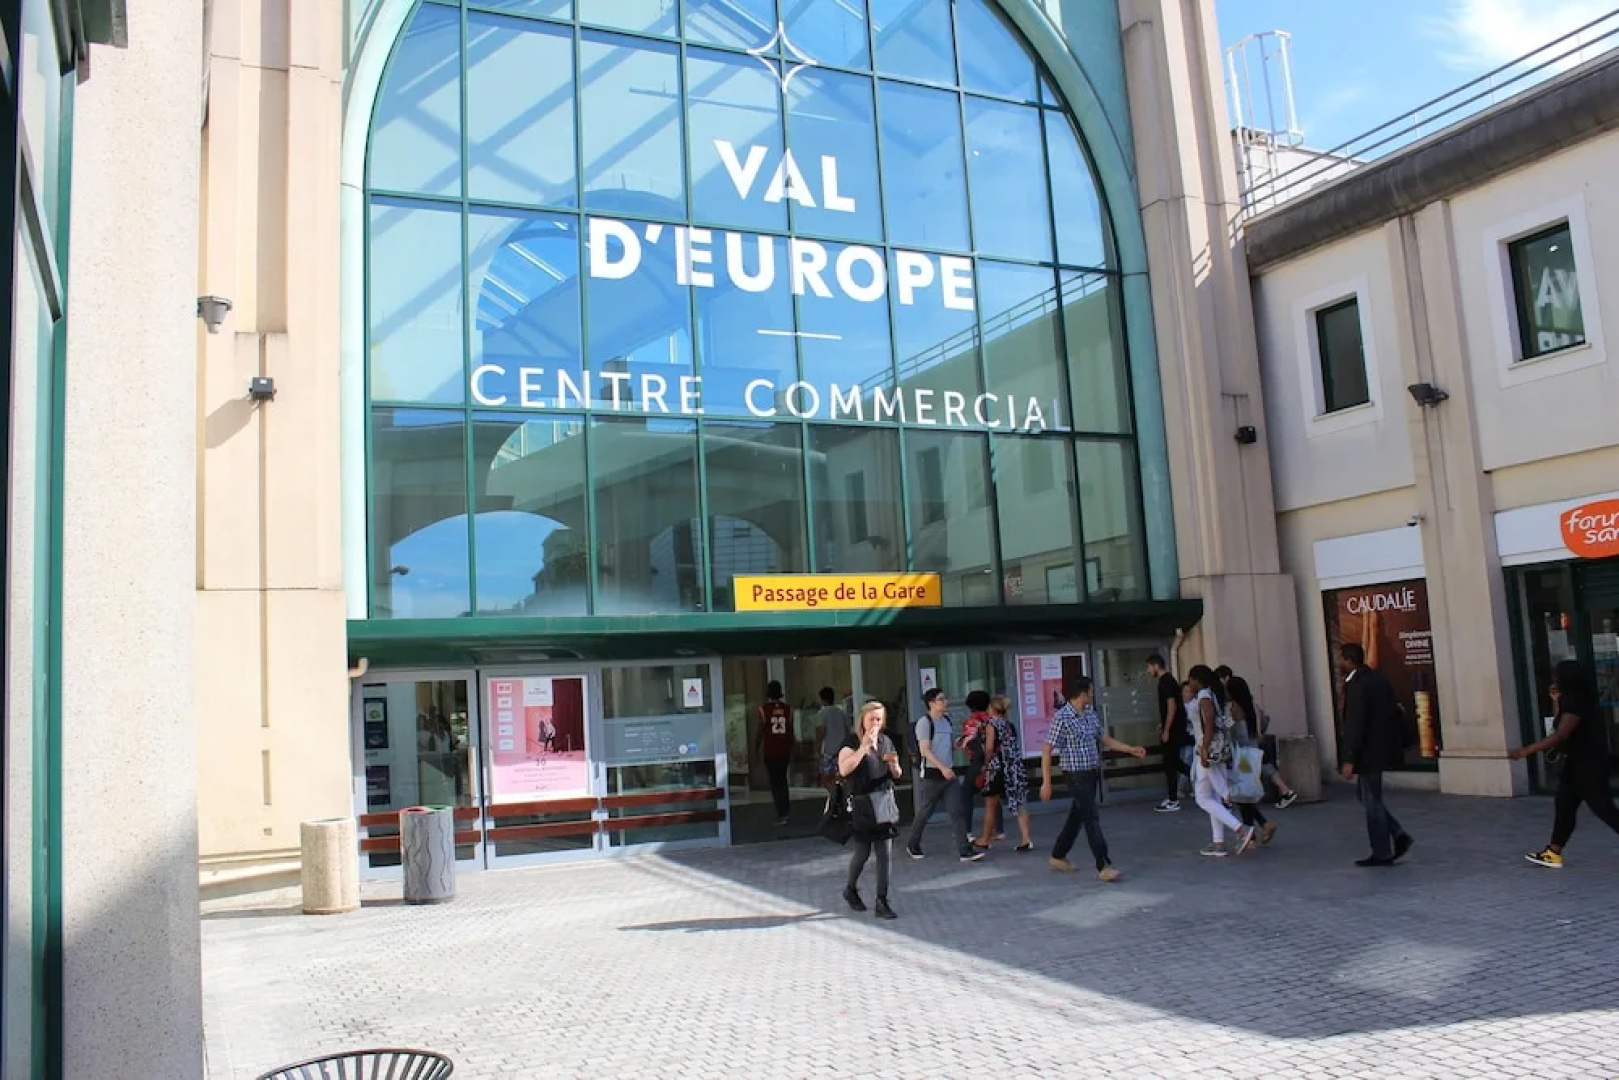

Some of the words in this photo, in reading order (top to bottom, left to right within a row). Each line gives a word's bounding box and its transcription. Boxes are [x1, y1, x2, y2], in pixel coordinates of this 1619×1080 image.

[713, 139, 855, 213] VAL
[588, 217, 975, 311] D'EUROPE
[470, 363, 705, 414] CENTRE
[752, 584, 828, 606] Passage
[834, 582, 856, 600] de
[862, 582, 877, 600] la
[883, 582, 926, 600] Gare
[771, 716, 786, 734] 23
